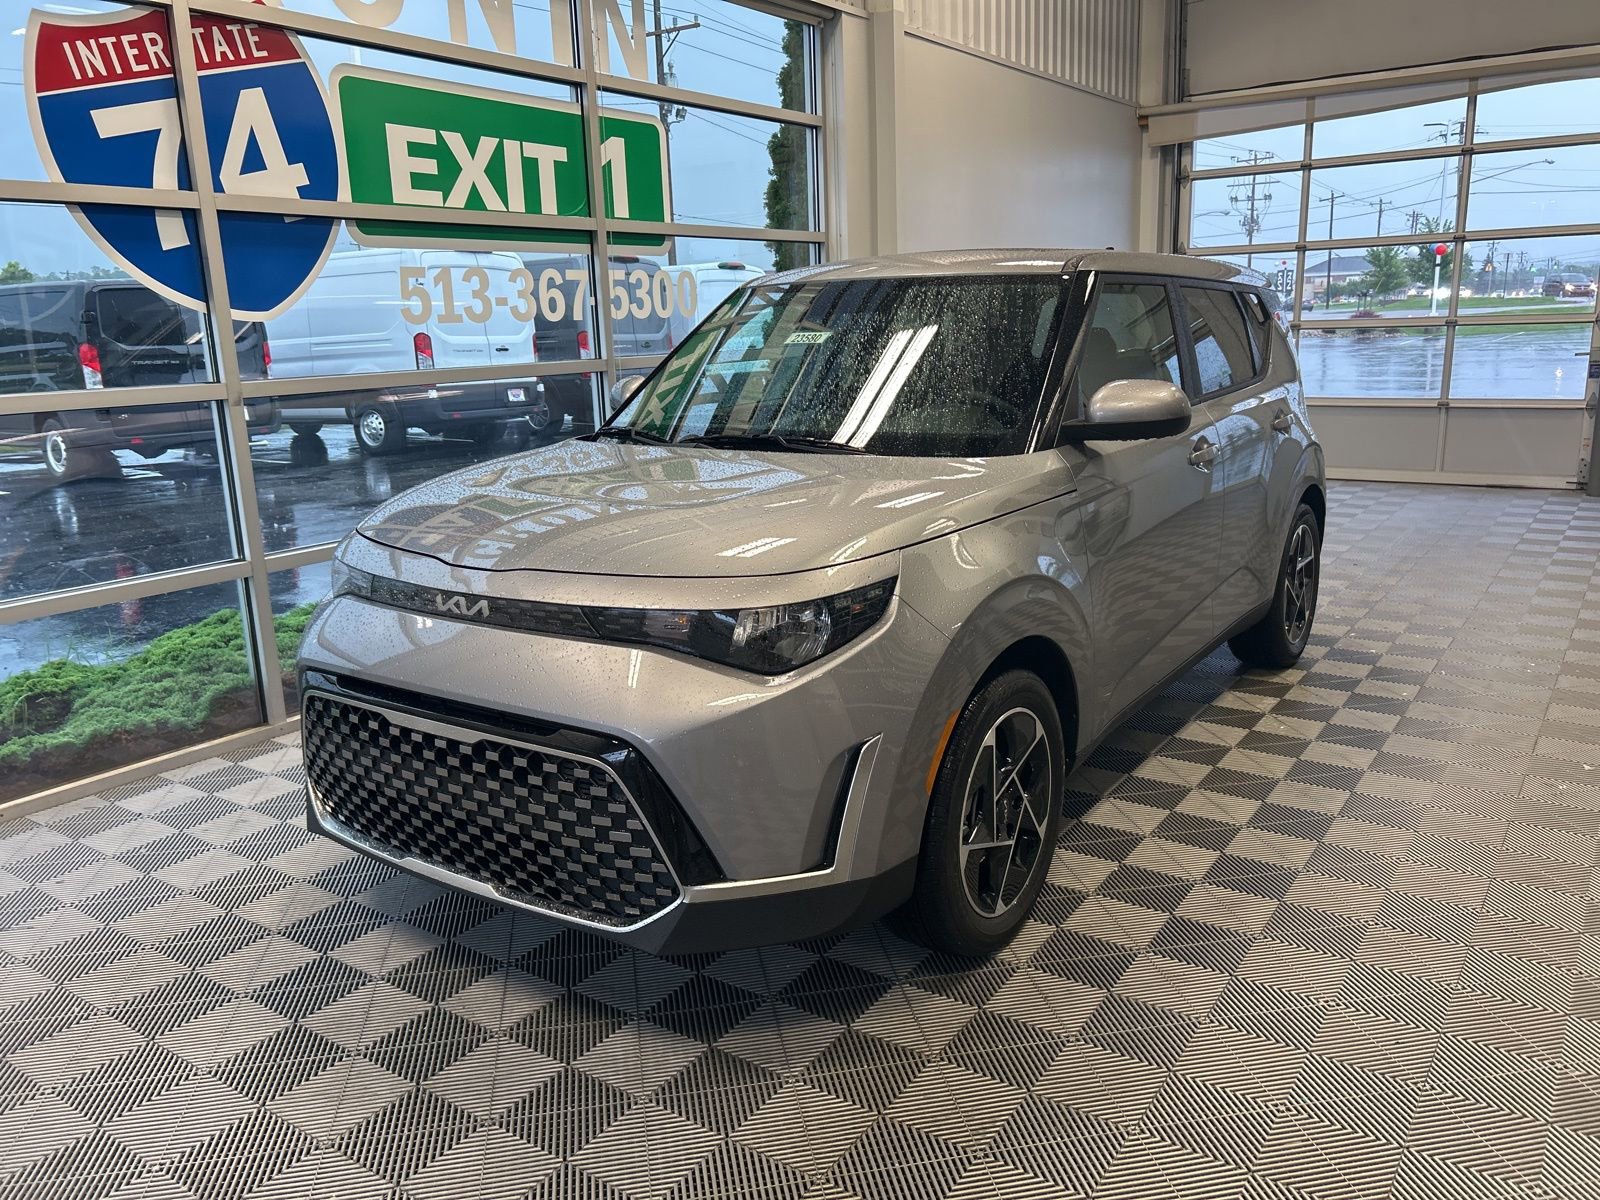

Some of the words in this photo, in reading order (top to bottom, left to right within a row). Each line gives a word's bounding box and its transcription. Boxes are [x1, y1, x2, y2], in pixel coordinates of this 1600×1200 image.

[62, 24, 269, 80] INTERTATE
[90, 86, 310, 251] 74
[385, 123, 568, 215] EXIT
[600, 136, 630, 219] 1
[791, 333, 823, 343] 23580
